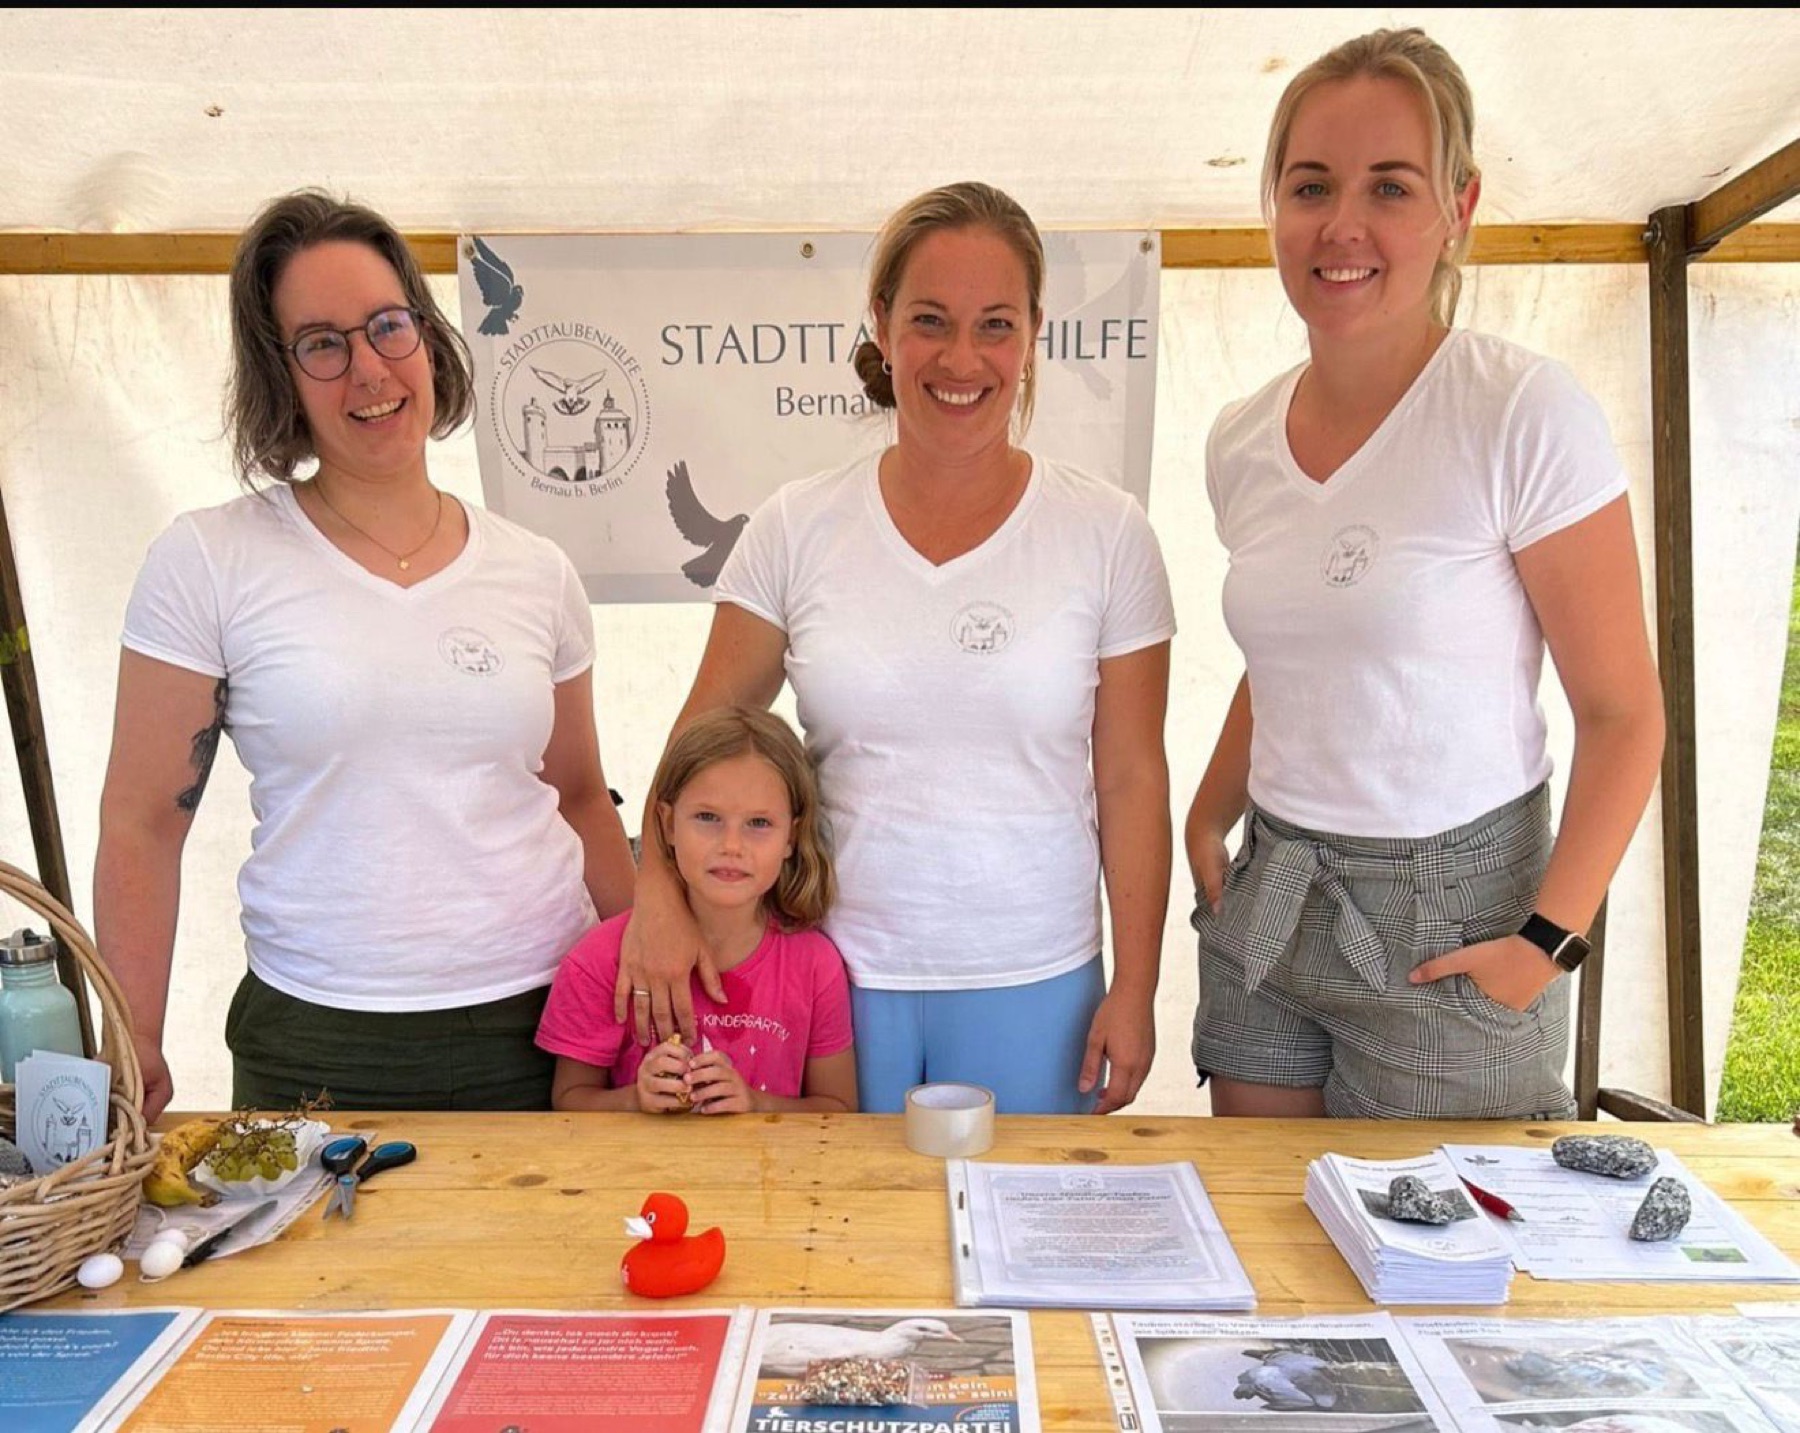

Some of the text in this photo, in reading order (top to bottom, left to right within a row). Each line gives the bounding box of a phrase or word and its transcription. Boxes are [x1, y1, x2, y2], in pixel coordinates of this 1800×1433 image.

[500, 322, 642, 377] STADTTAUBENHILFE
[530, 475, 624, 498] Bernau b. Berlin
[703, 1013, 790, 1042] KINDERGARTN
[755, 1418, 1011, 1433] TIERSCHUTZPARTEI
